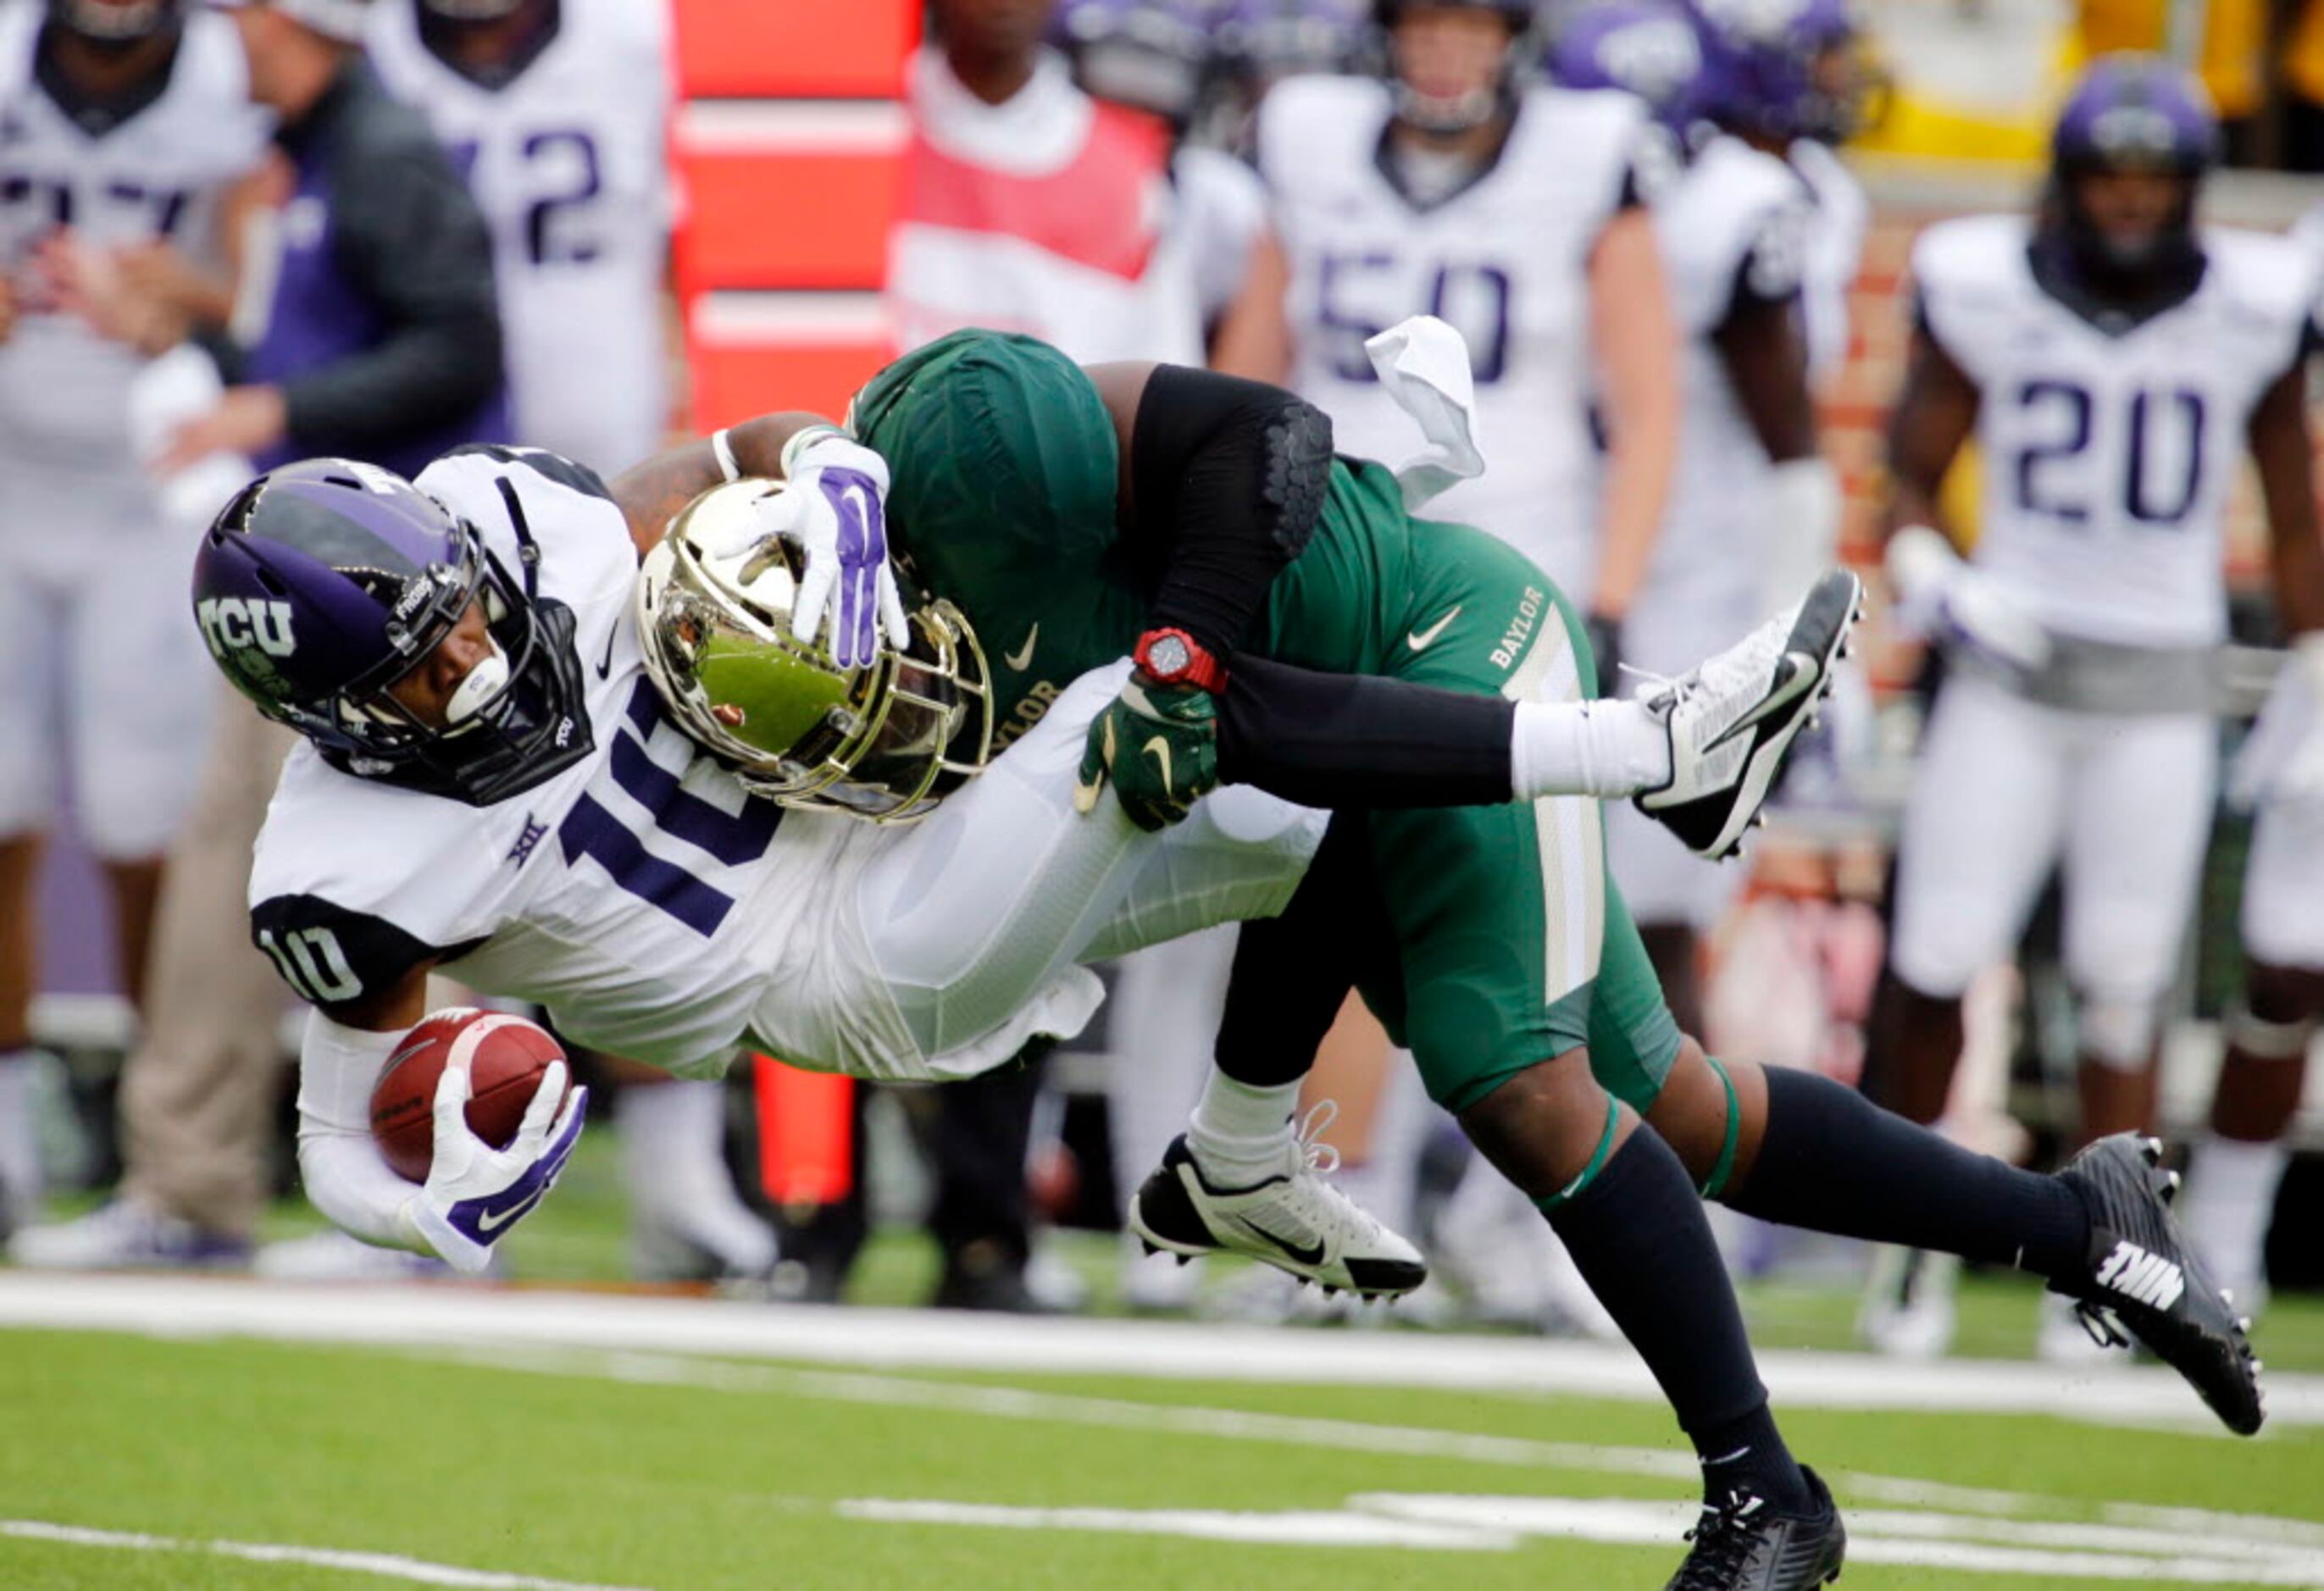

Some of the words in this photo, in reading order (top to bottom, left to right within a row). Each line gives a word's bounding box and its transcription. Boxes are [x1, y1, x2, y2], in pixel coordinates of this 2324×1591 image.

[1317, 252, 1508, 384] 50
[2018, 380, 2205, 522] 20
[198, 597, 296, 657] TCU
[1489, 585, 1544, 670] BAYLOR
[556, 717, 574, 747] TCU
[508, 811, 550, 871] XII
[259, 926, 363, 1002] 10
[2096, 1239, 2184, 1311] NIKE
